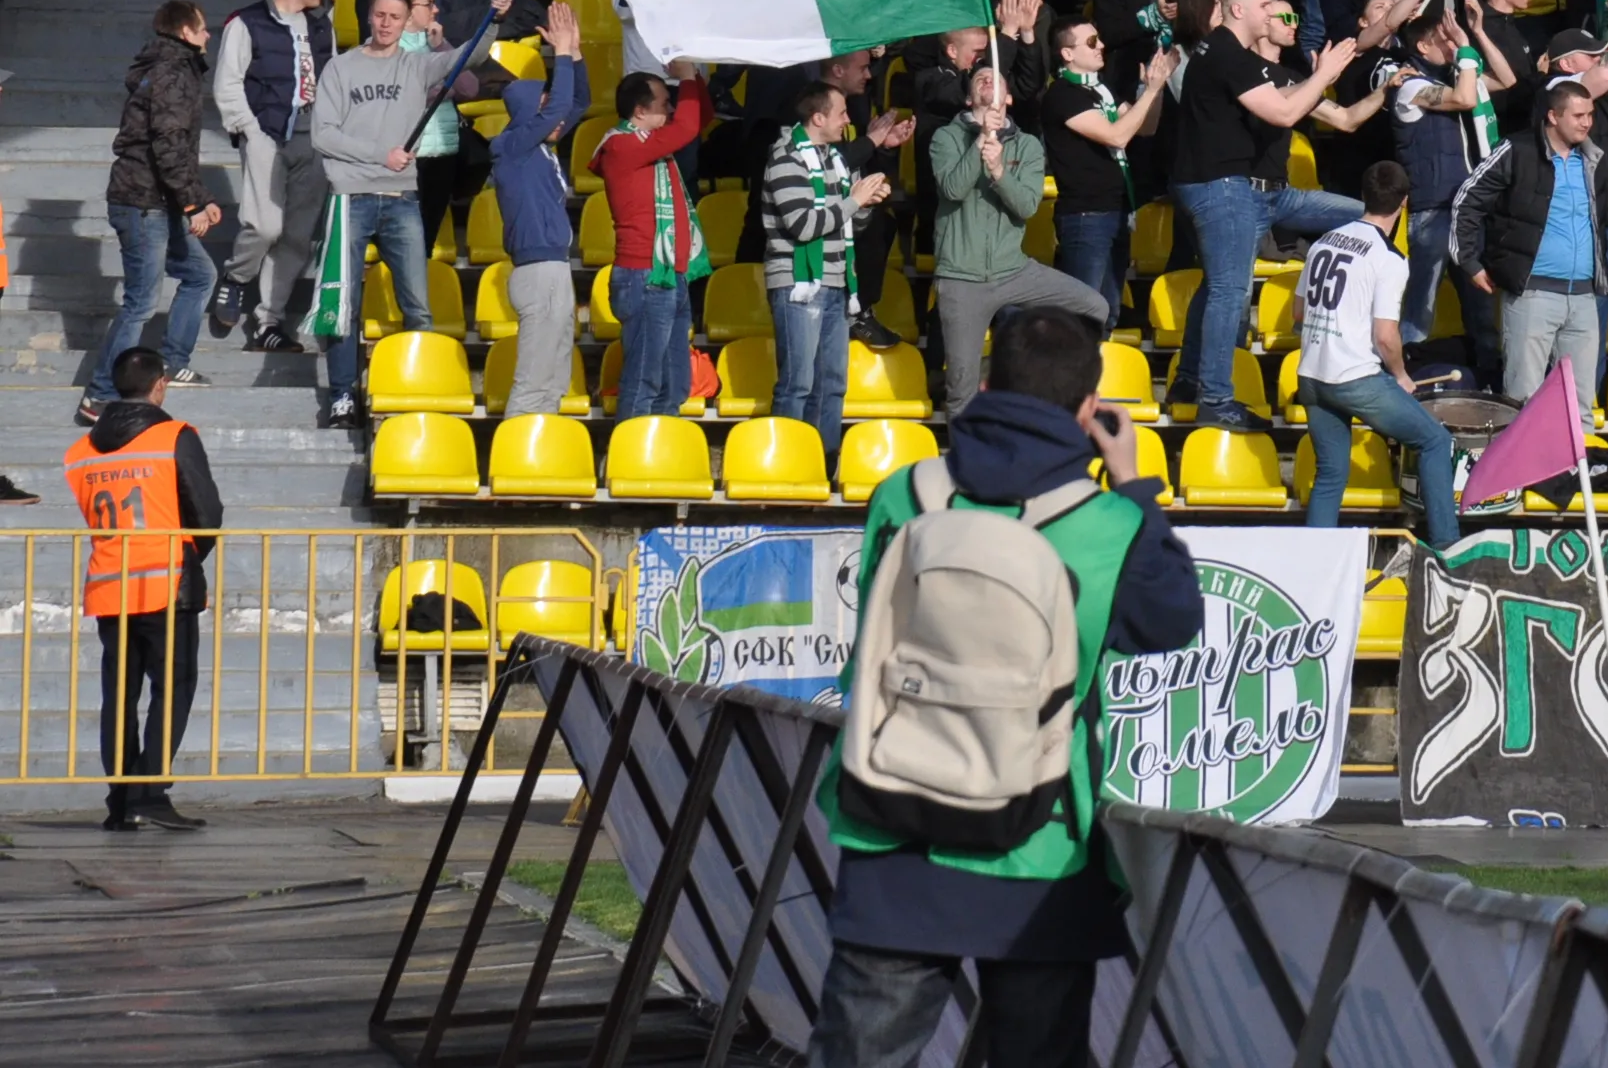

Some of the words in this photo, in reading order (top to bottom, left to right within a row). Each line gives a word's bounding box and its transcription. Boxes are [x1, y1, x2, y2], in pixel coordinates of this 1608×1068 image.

[349, 83, 402, 105] NORSE
[1306, 248, 1355, 311] 95
[85, 467, 153, 484] STEWARD
[93, 485, 148, 540] 01
[733, 635, 796, 670] СФК
